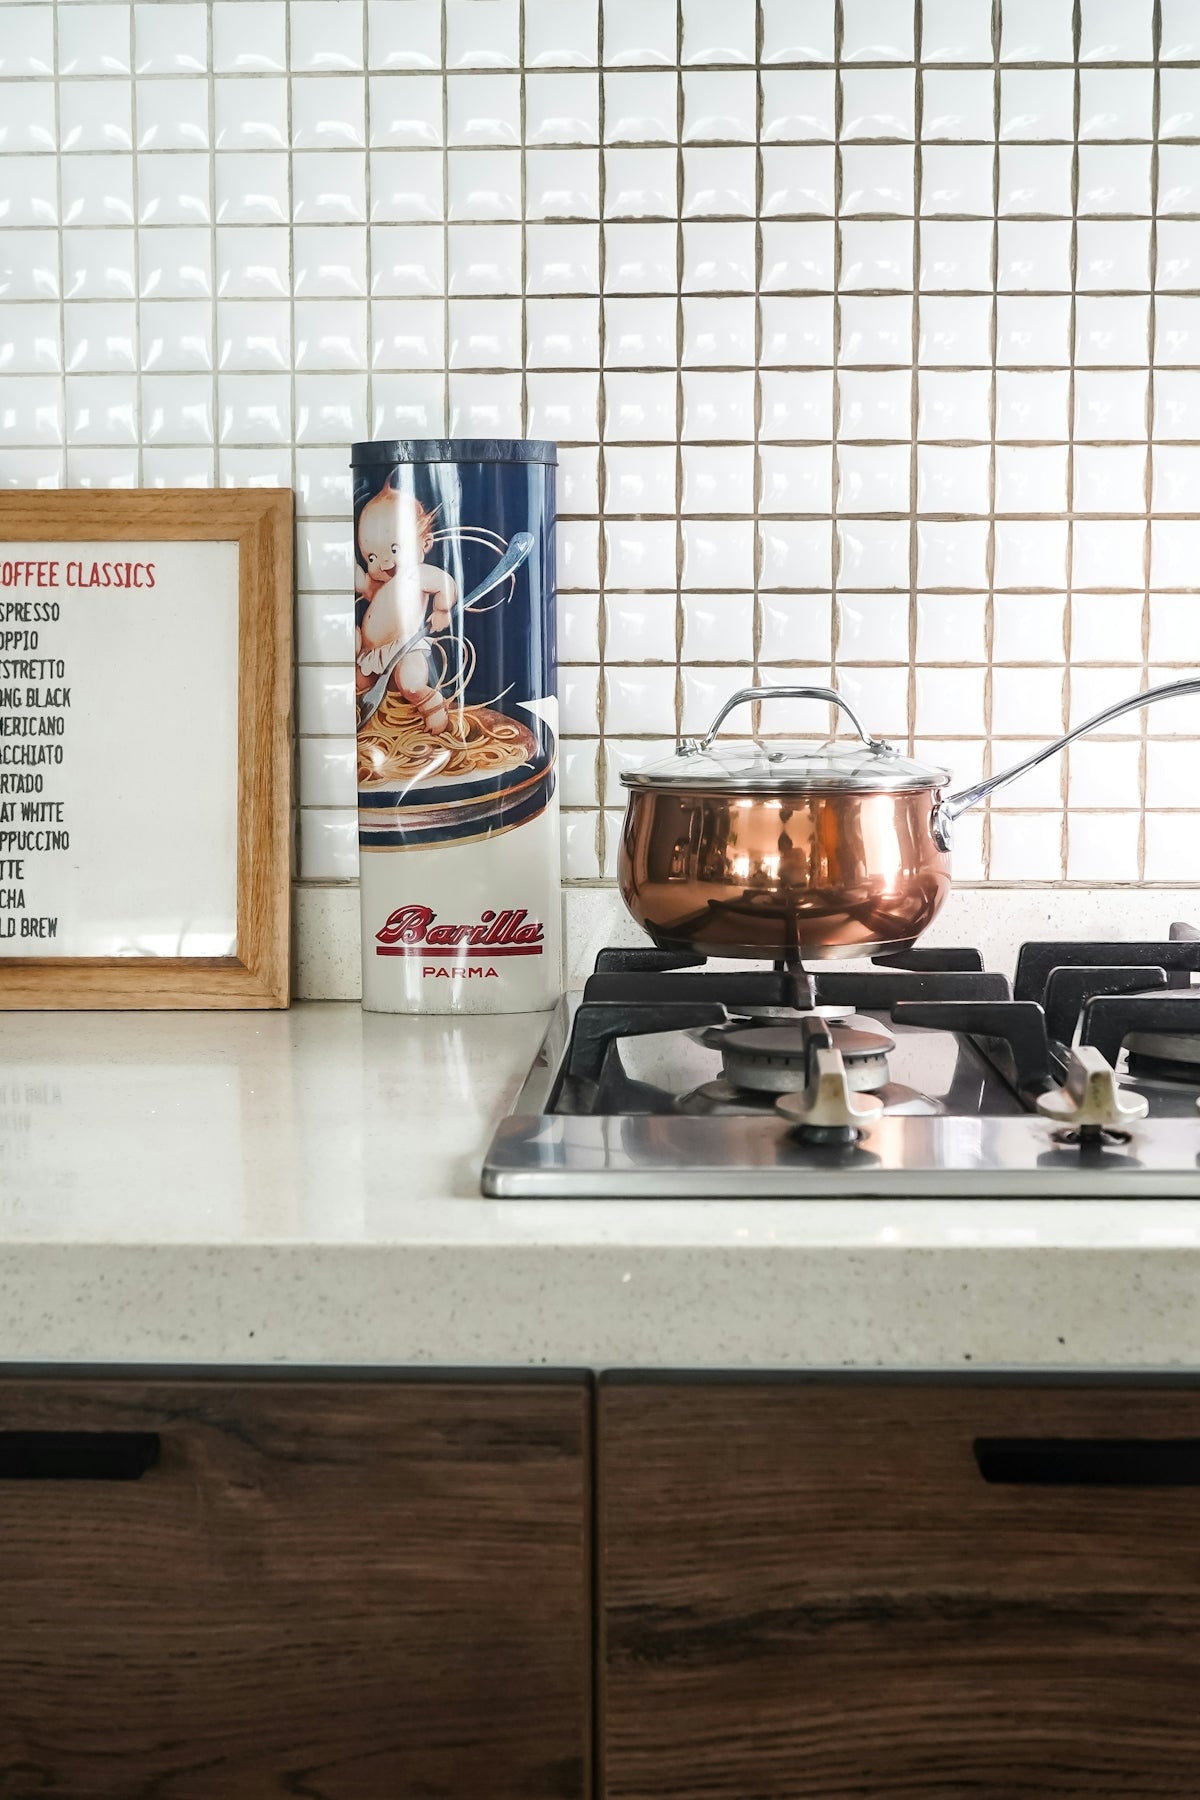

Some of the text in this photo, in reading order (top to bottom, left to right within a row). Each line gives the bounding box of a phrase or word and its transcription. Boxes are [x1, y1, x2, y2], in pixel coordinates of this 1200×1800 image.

[0, 562, 156, 588] OFFEE CLASSICS
[26, 687, 71, 708] BLACK
[20, 802, 64, 822] WHITE
[20, 917, 58, 938] BREW
[375, 904, 545, 946] Barilla
[422, 967, 499, 979] PARMA
